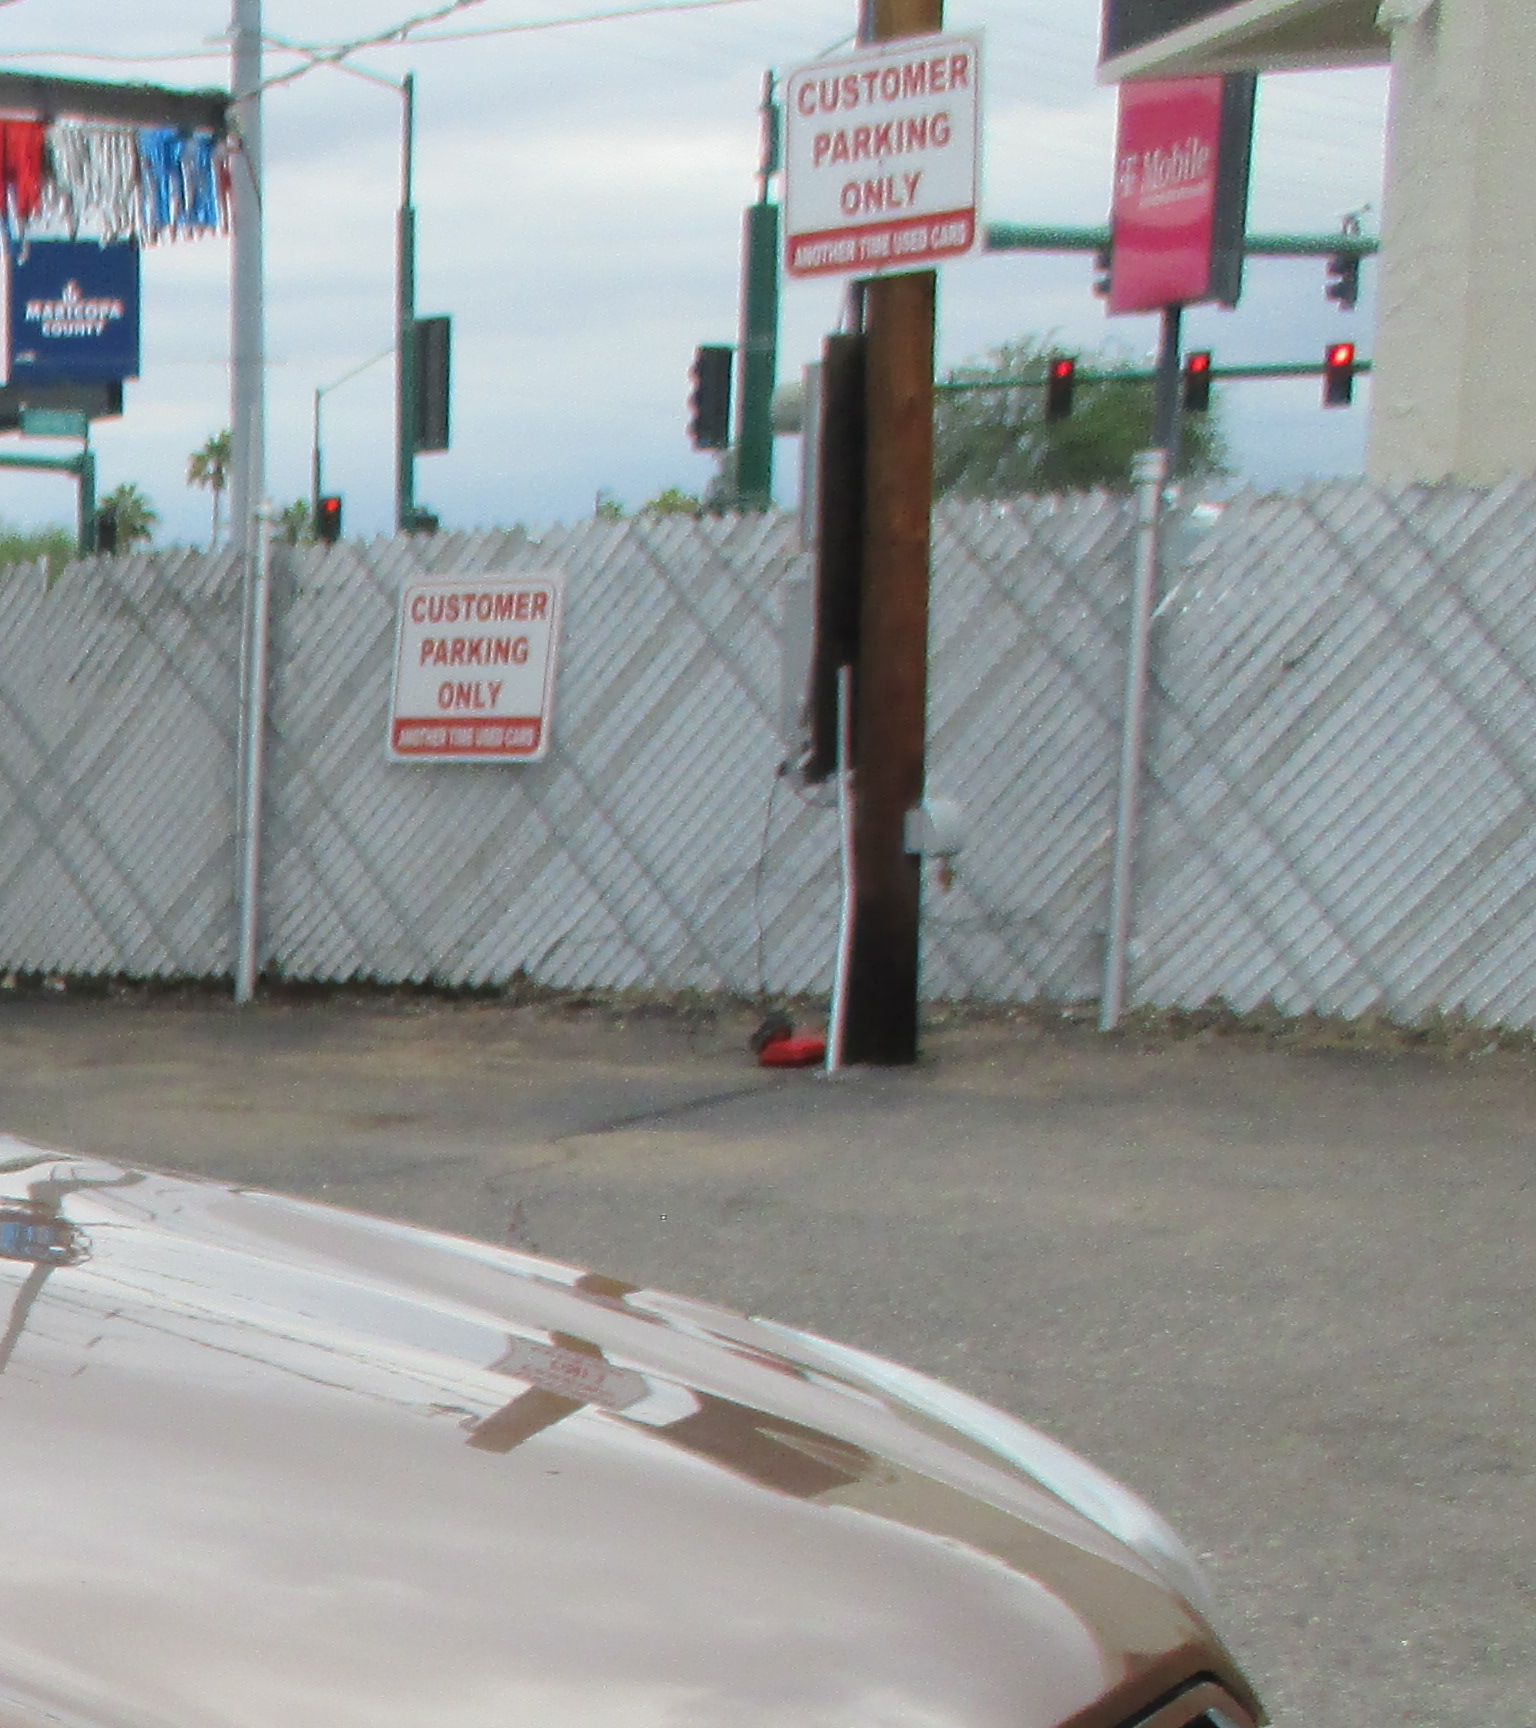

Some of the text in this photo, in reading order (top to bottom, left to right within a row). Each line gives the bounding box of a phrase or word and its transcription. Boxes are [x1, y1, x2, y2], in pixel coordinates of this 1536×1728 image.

[796, 53, 969, 117] CUSTOMER
[812, 111, 951, 169] PARKING
[839, 171, 921, 217] ONLY
[25, 300, 124, 322] MARICOPA
[41, 319, 106, 339] COUNTY
[411, 591, 548, 625] CUSTOMER
[419, 636, 530, 668] PARKING
[437, 680, 503, 710] ONLY
